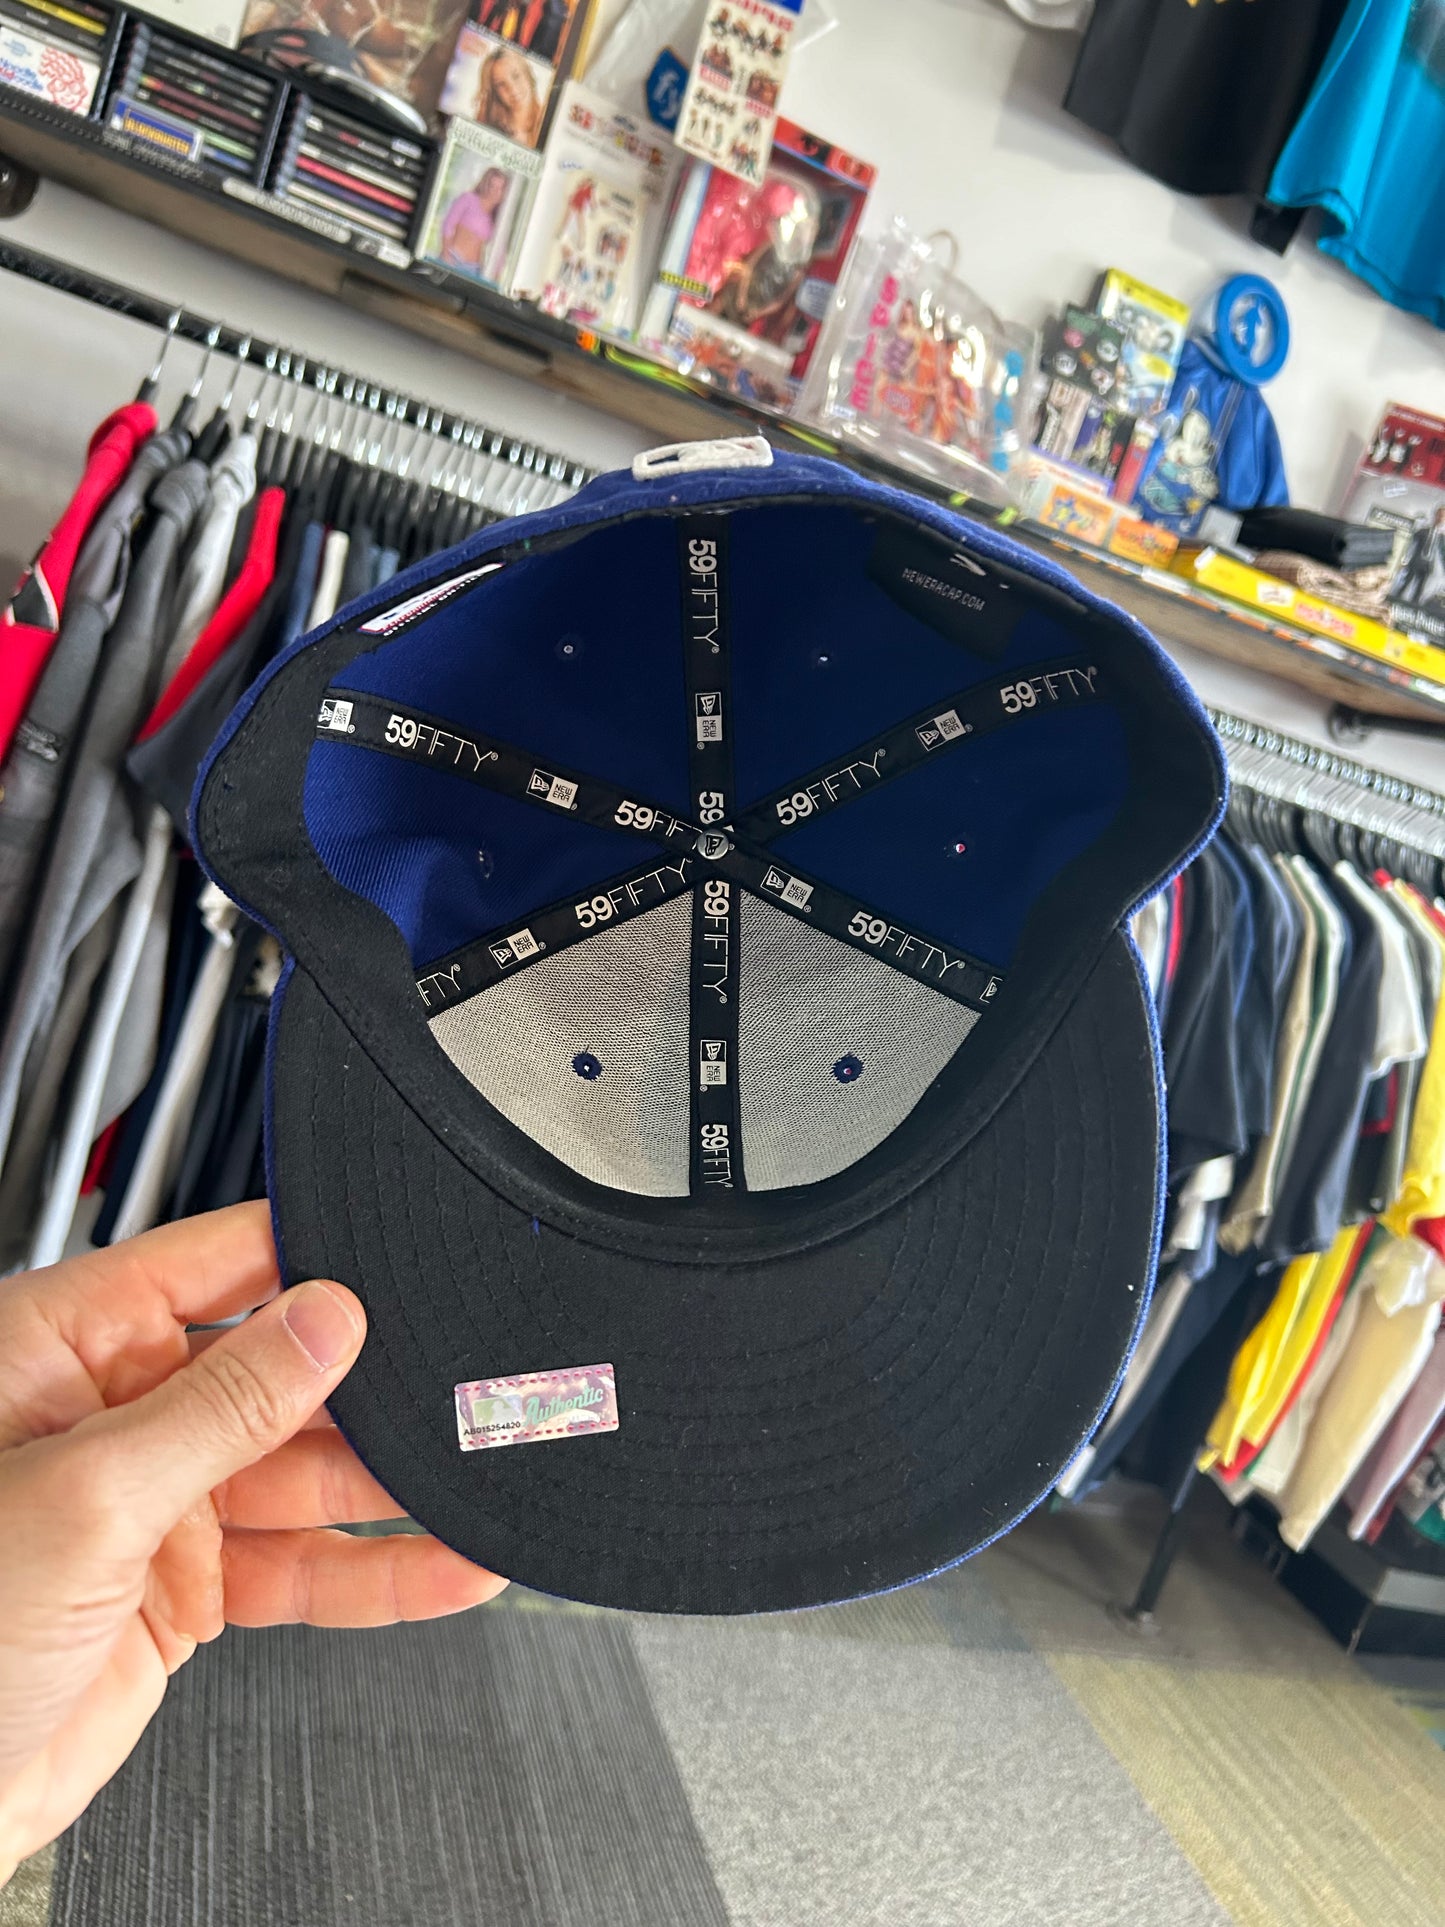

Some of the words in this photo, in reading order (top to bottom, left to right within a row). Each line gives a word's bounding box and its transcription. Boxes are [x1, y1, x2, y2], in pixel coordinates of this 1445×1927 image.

[901, 567, 986, 612] NEWERACAP.COM
[552, 791, 570, 802] ERA
[555, 784, 573, 796] NEW
[614, 800, 703, 842] 59FIF
[787, 890, 804, 903] ERA
[790, 883, 808, 897] NEW
[513, 934, 531, 947] NEW
[517, 943, 535, 954] ERA
[526, 1387, 604, 1427] Authentic
